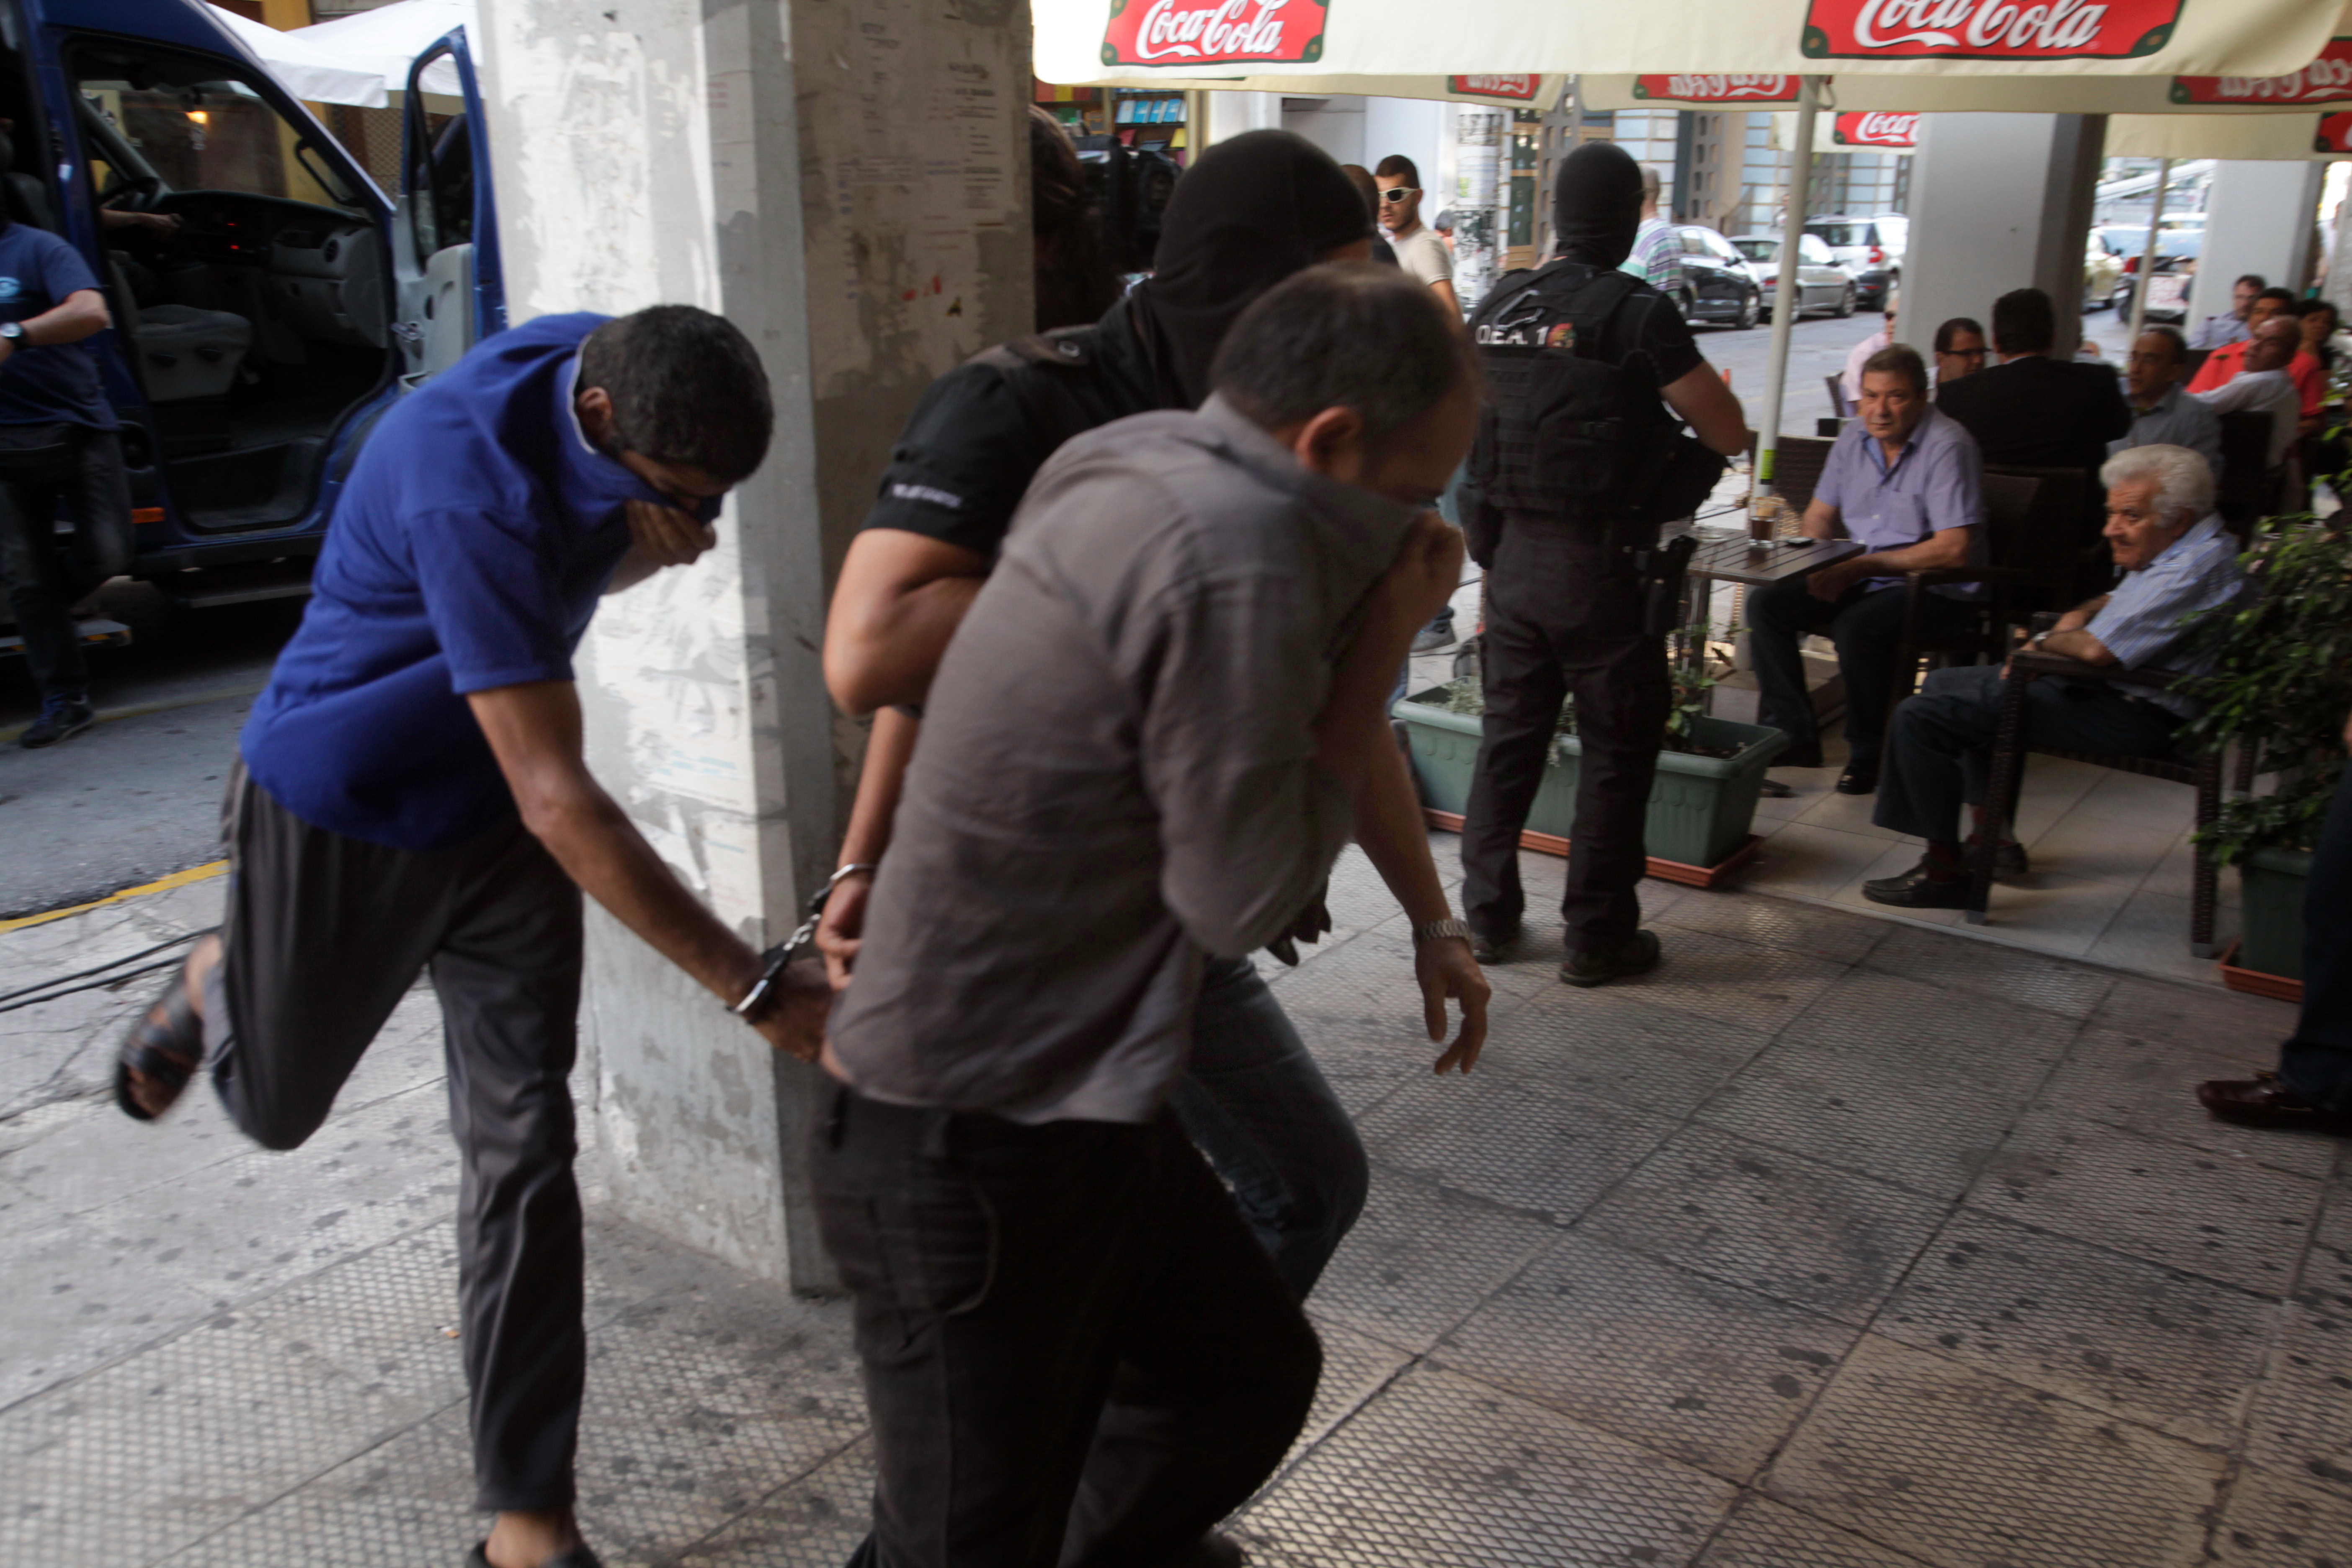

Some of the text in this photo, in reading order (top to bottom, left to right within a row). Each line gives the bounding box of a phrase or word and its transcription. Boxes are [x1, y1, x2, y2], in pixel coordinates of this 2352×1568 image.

[1135, 0, 1284, 59] Coca-Cola
[1853, 0, 2108, 48] CocaCola
[1536, 326, 1549, 345] 1
